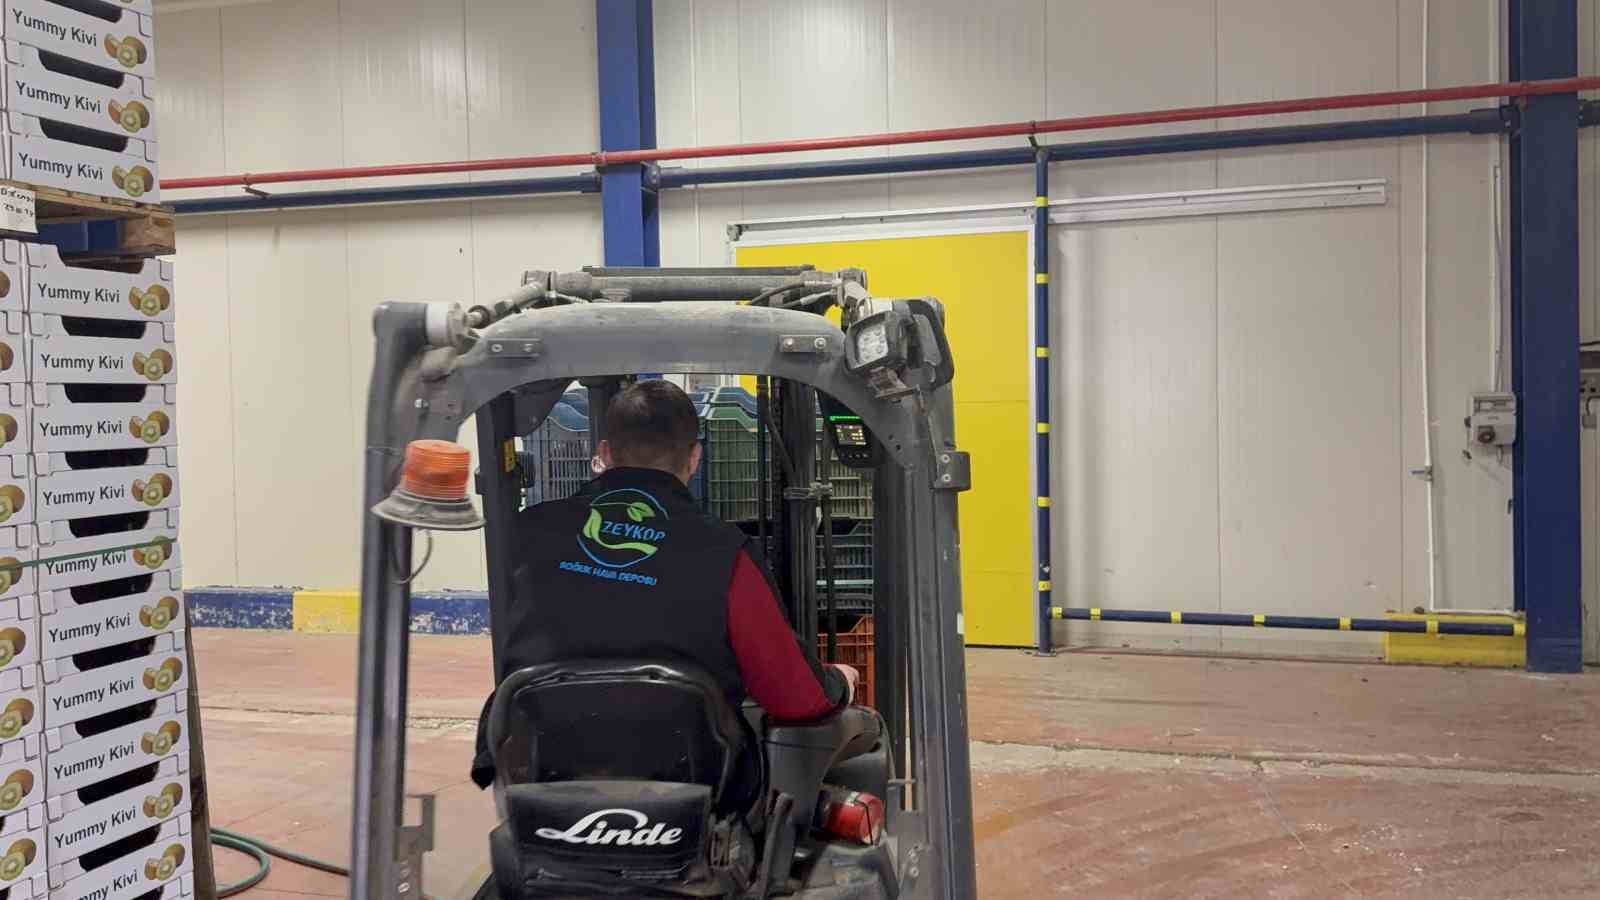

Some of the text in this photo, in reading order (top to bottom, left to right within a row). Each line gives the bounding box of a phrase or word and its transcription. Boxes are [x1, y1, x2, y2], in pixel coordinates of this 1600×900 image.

[13, 7, 97, 49] Yummy Kivi
[16, 80, 102, 114] Yummy Kivi
[18, 152, 104, 181] Yummy Kivi
[37, 284, 121, 304] Yummy Kivi
[41, 354, 124, 372] Yummy Kivi
[41, 420, 123, 438] Yummy Kivi
[43, 485, 125, 505] Yummy Kivi
[46, 551, 127, 575] Yummy Kivi
[49, 612, 131, 643] Yummy Kivi
[52, 676, 135, 711] Yummy Kivi
[54, 741, 135, 780] Yummy Kivi
[54, 806, 136, 849] Yummy Kivi
[535, 808, 683, 845] Linde
[113, 870, 137, 892] Kivi
